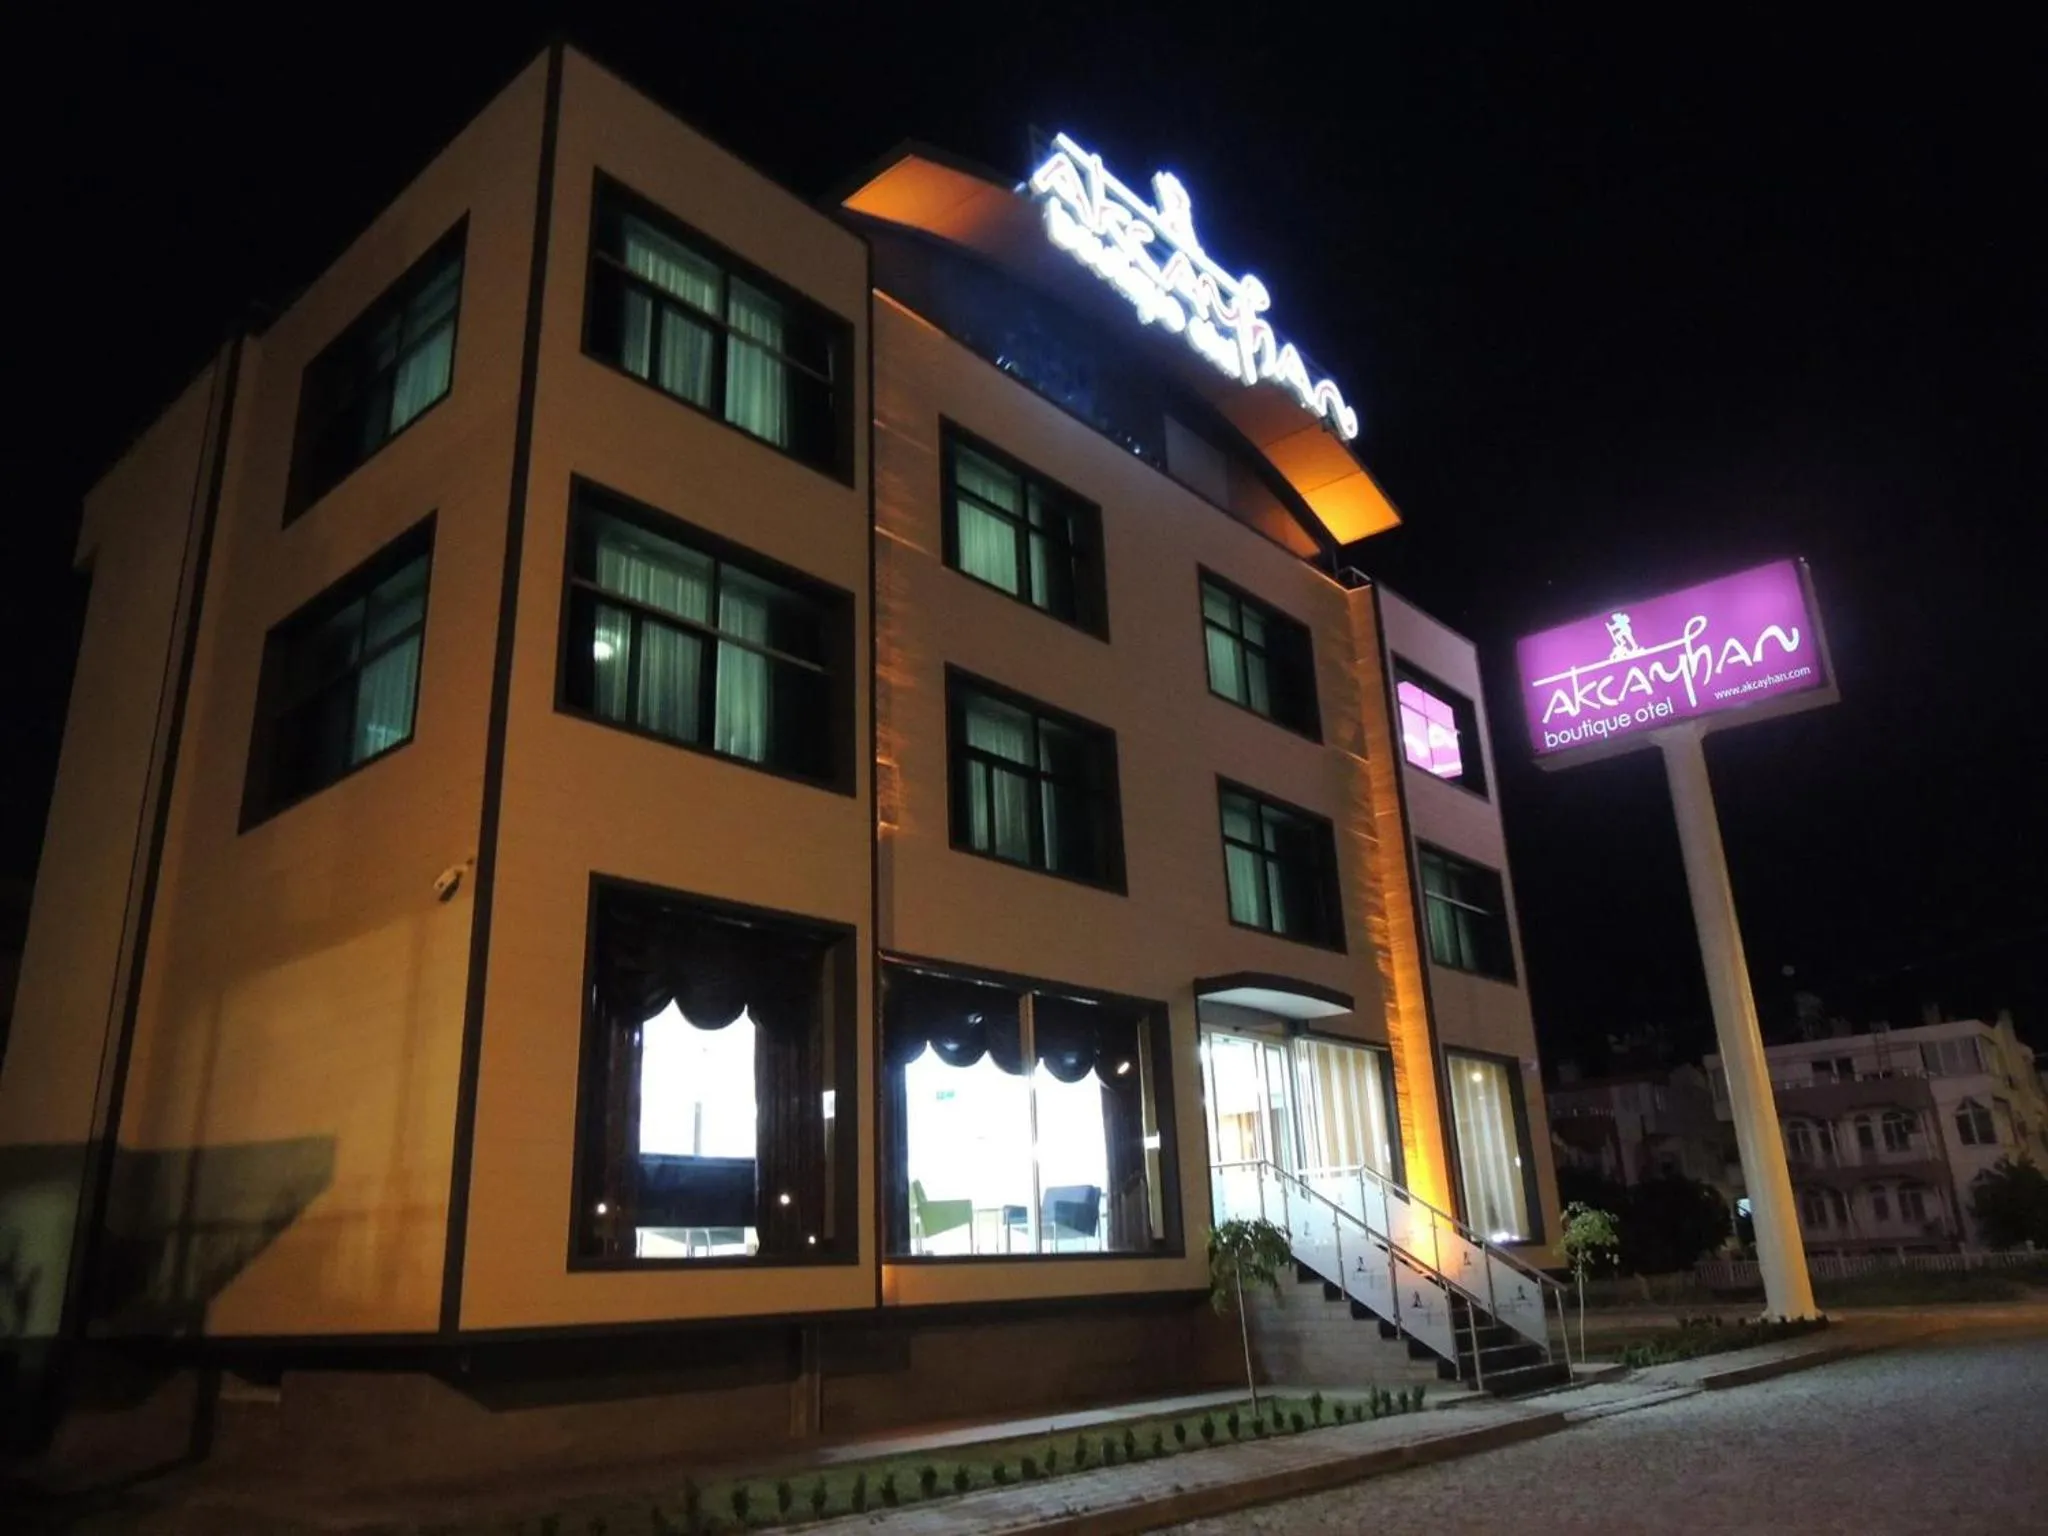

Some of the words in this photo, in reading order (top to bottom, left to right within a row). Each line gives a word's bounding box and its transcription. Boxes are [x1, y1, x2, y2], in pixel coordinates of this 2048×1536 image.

[1713, 665, 1811, 701] www.akcayhan.com
[1544, 710, 1632, 748] boutique
[1634, 696, 1674, 721] otel
